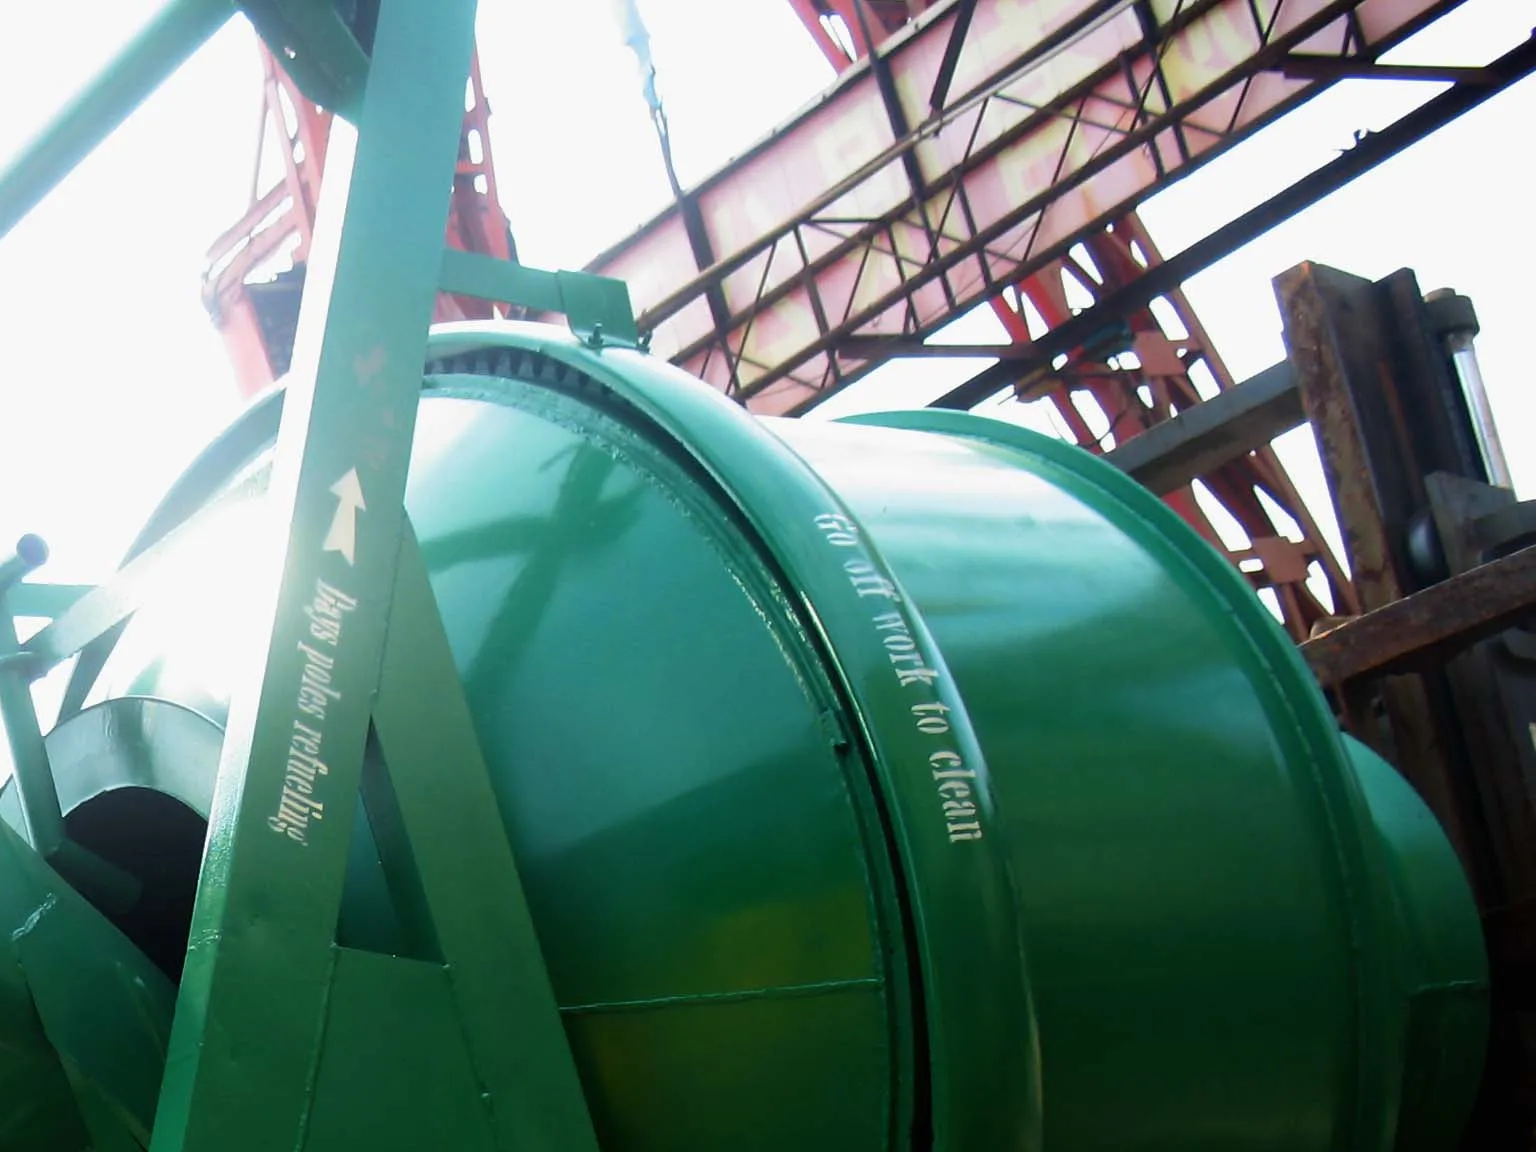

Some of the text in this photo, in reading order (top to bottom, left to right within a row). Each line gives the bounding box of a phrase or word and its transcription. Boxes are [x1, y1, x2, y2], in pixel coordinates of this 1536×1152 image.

[842, 560, 901, 602] off
[297, 641, 342, 721] poles
[871, 612, 940, 688] work
[910, 701, 952, 735] to
[267, 719, 329, 847] refueling
[928, 750, 983, 844] clean
